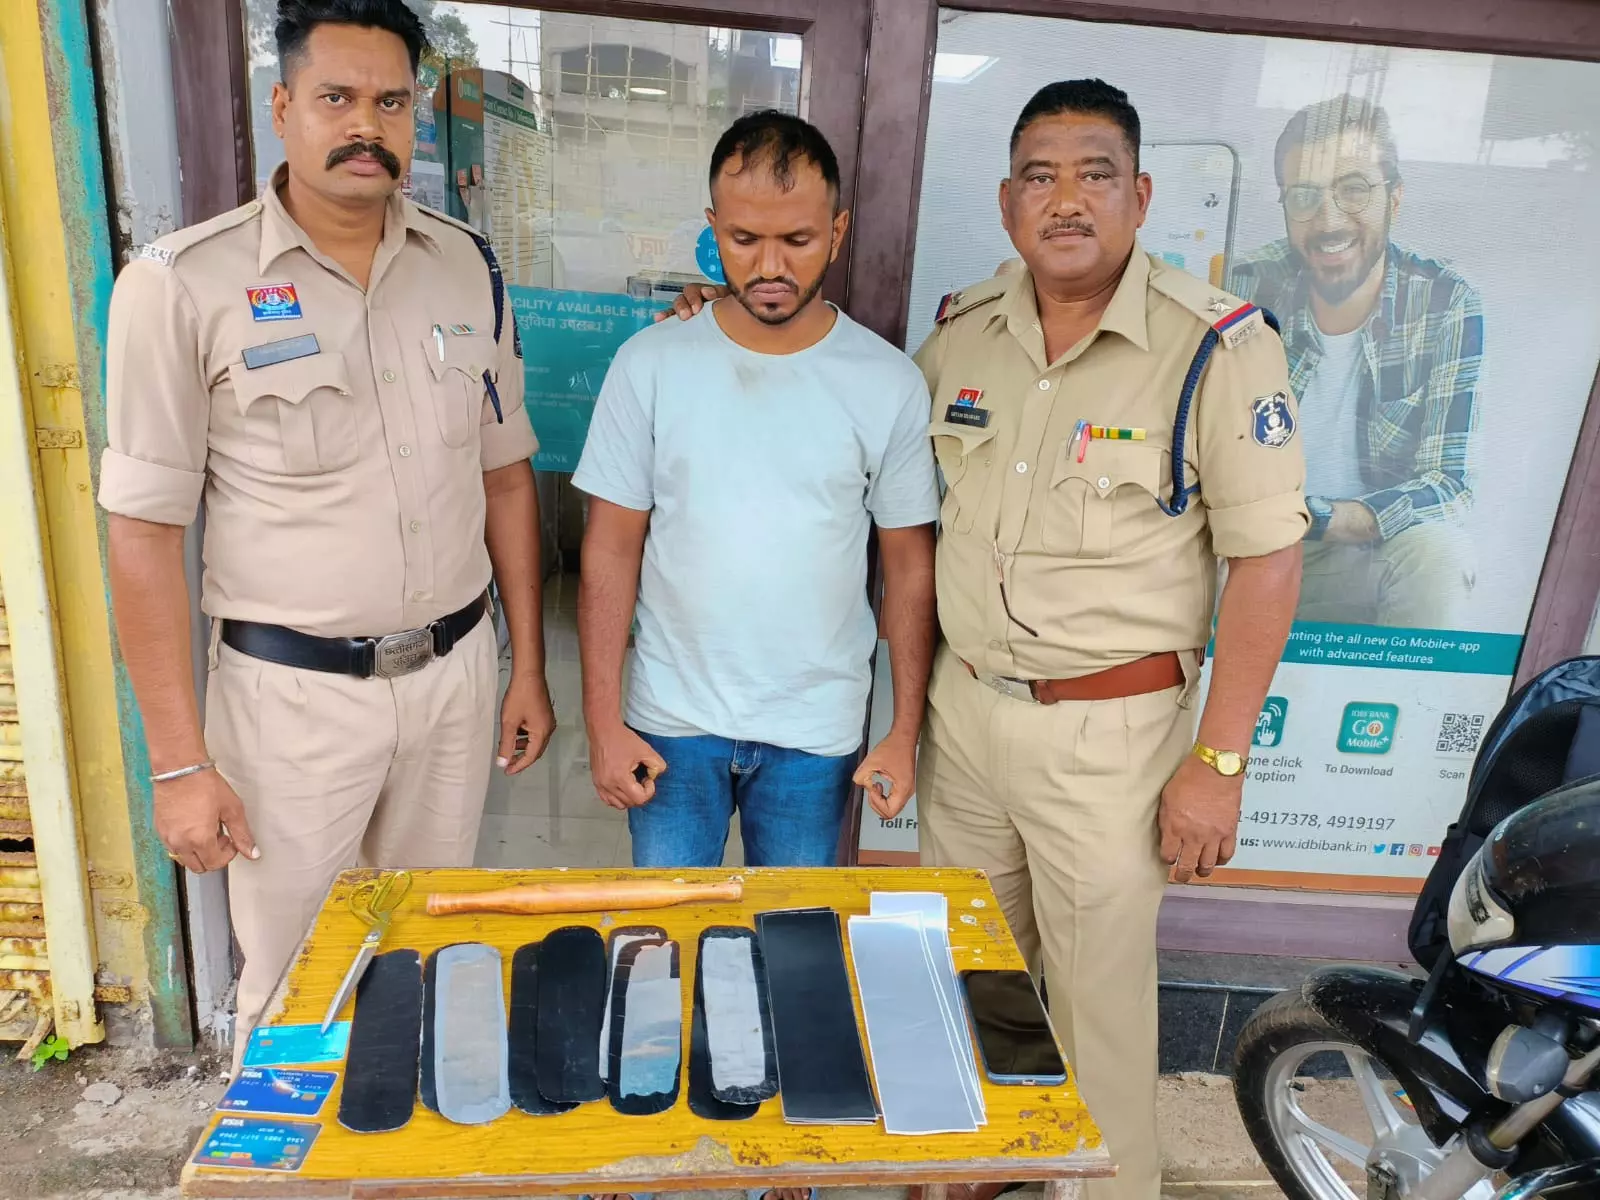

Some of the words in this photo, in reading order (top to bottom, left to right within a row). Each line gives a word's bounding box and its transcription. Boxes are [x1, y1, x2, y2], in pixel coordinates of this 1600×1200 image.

[557, 301, 628, 317] AVAILABLE
[1325, 632, 1344, 644] the
[1346, 633, 1361, 645] all
[1363, 636, 1388, 646] new
[1390, 636, 1407, 647] Go
[1409, 637, 1456, 650] Mobile+
[1458, 642, 1480, 654] app
[1299, 646, 1324, 659] with
[1327, 648, 1384, 662] advanced
[1386, 651, 1434, 664] features
[1369, 710, 1390, 720] BANK
[1272, 755, 1303, 768] click
[1254, 769, 1296, 783] option
[1324, 763, 1338, 774] To
[1339, 764, 1394, 777] Download
[1439, 769, 1466, 779] Scan
[879, 817, 903, 829] Toll
[1326, 815, 1396, 831] 4919197
[1240, 838, 1260, 848] us:
[1262, 839, 1368, 853] www.idbibank.in
